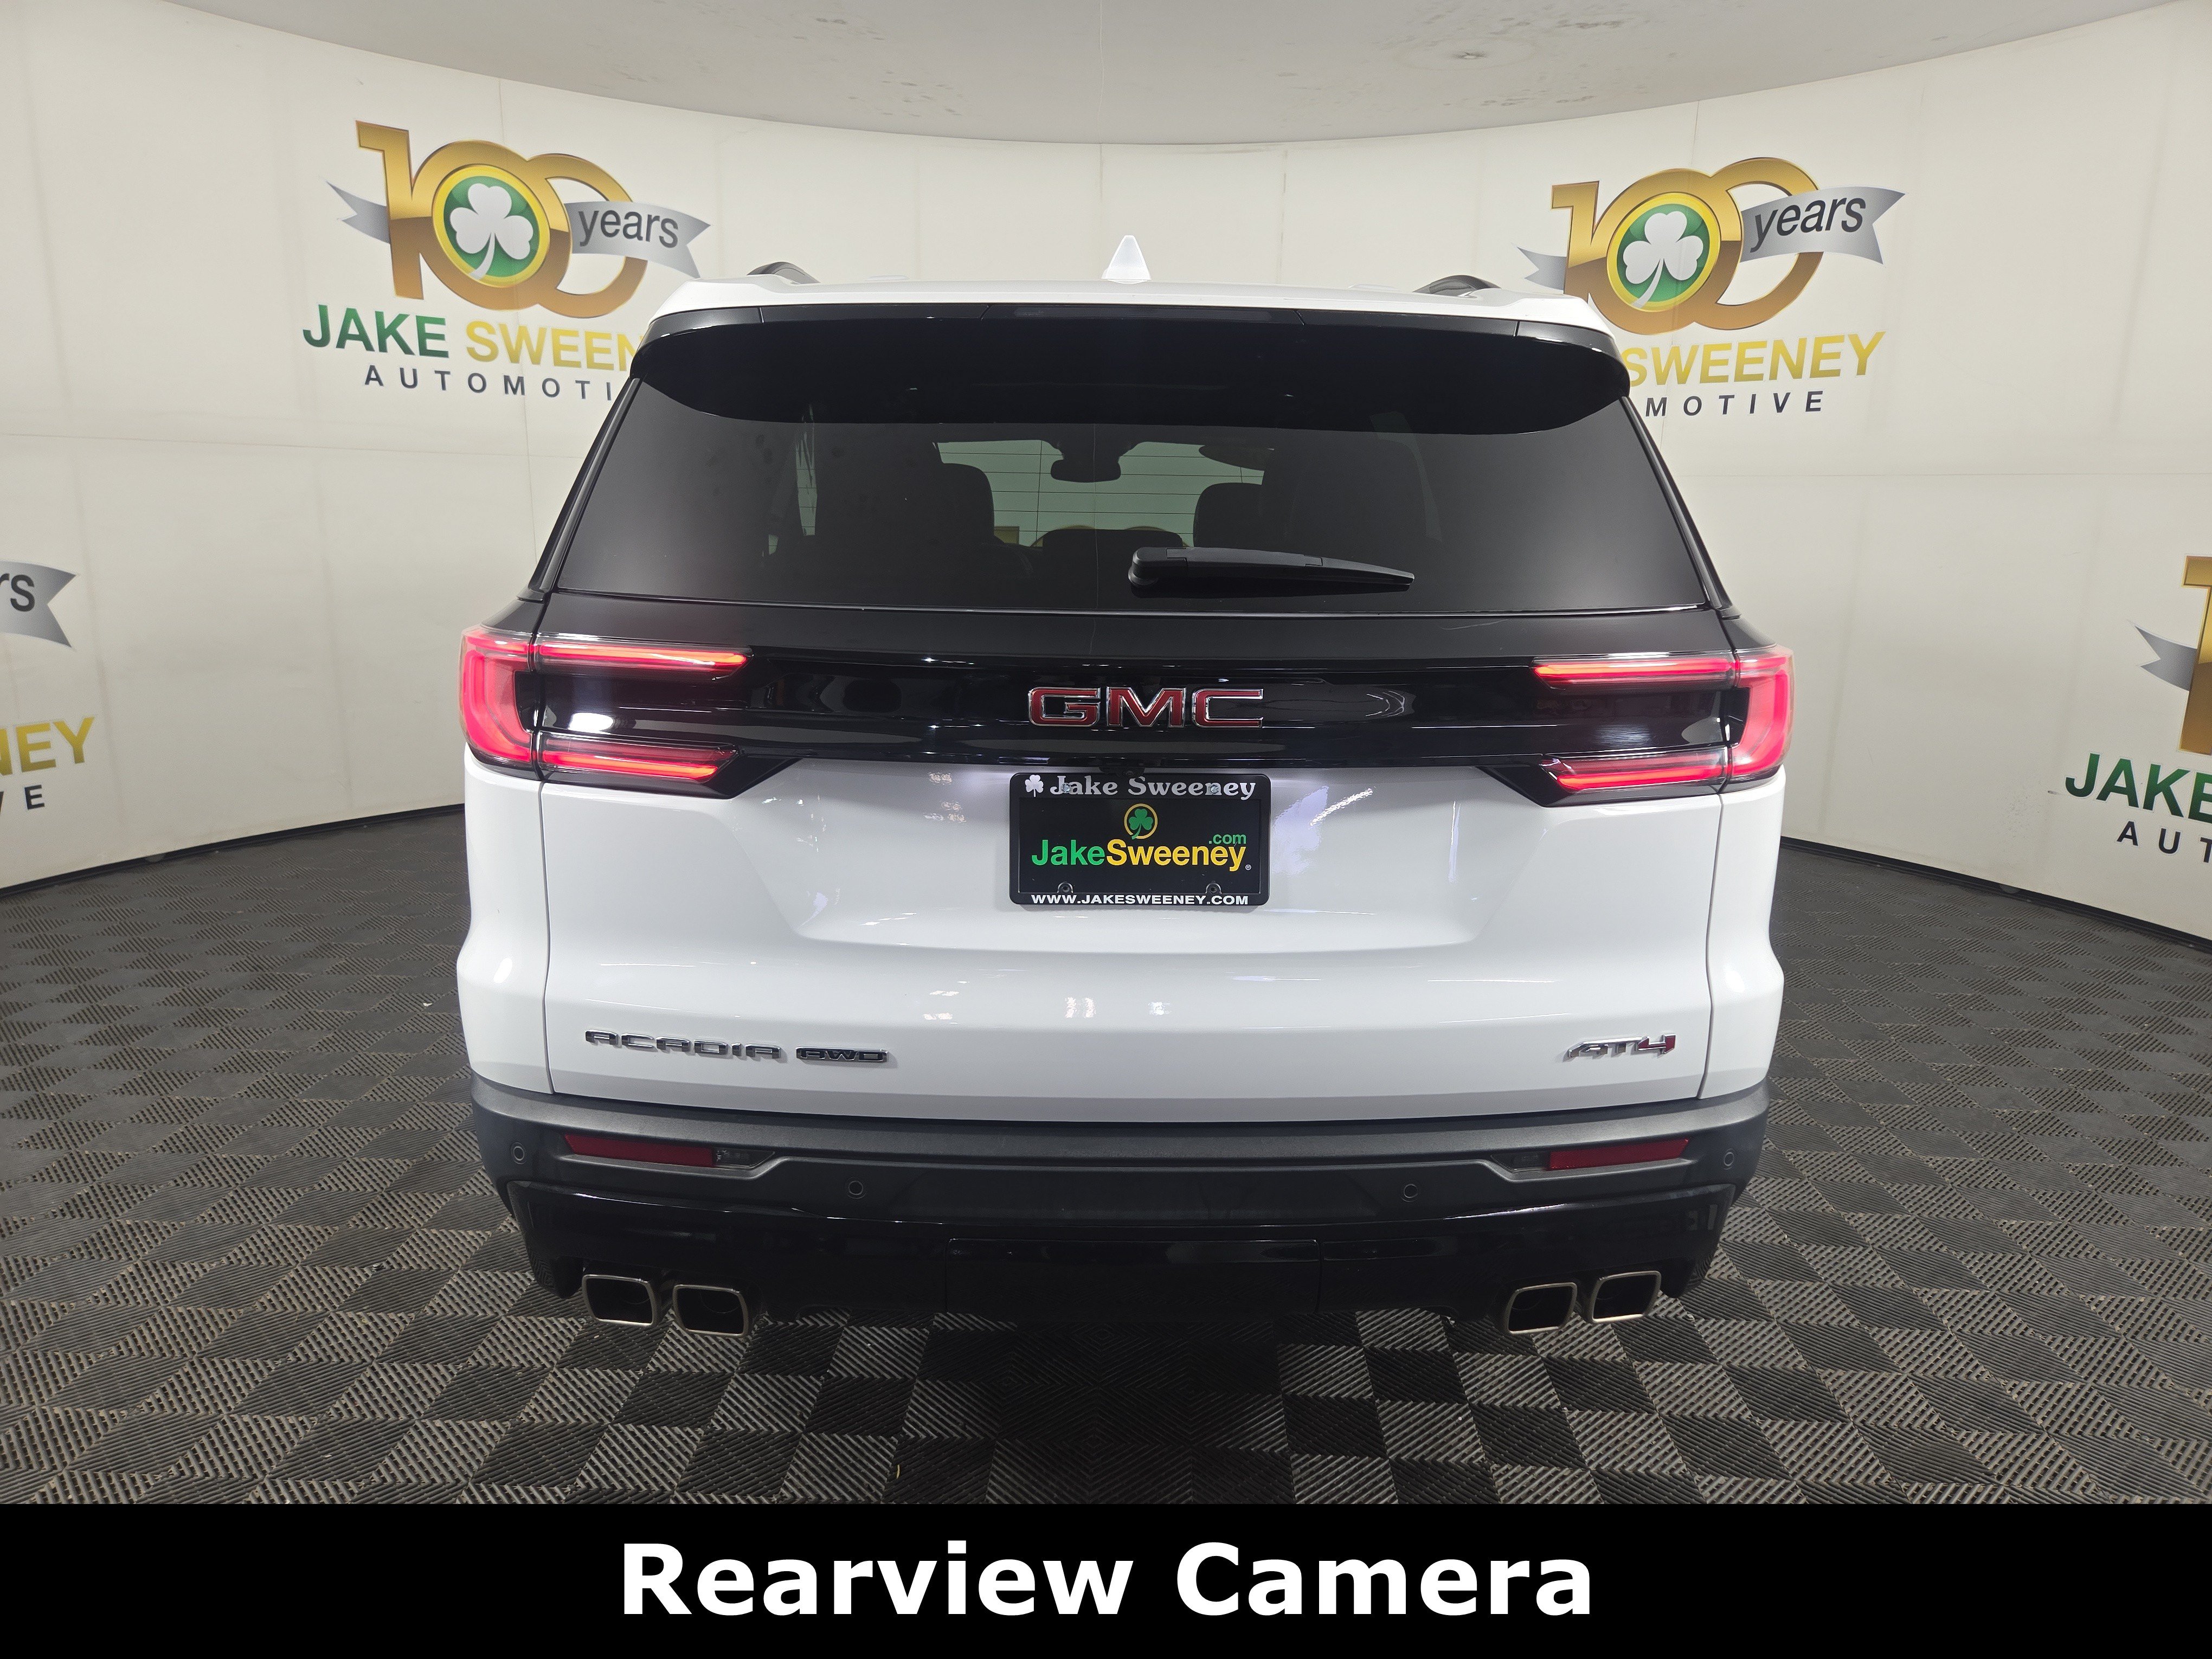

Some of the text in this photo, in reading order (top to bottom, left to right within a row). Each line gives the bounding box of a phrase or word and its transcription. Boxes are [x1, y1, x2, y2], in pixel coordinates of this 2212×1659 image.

[578, 209, 679, 248] years
[1750, 197, 1866, 253] years
[303, 304, 449, 359] JAKE
[1621, 331, 1886, 388] SWEENEY
[364, 364, 612, 401] AUTOMOTI
[1645, 390, 1824, 417] MOTIVE
[1028, 686, 1264, 729] GMC
[1050, 775, 1256, 800] Jake Sweeney
[1031, 895, 1249, 905] WWW.JAKESWEENEY.COM
[585, 1029, 888, 1063] ACADIA AWD
[1565, 1033, 1676, 1058] AT4
